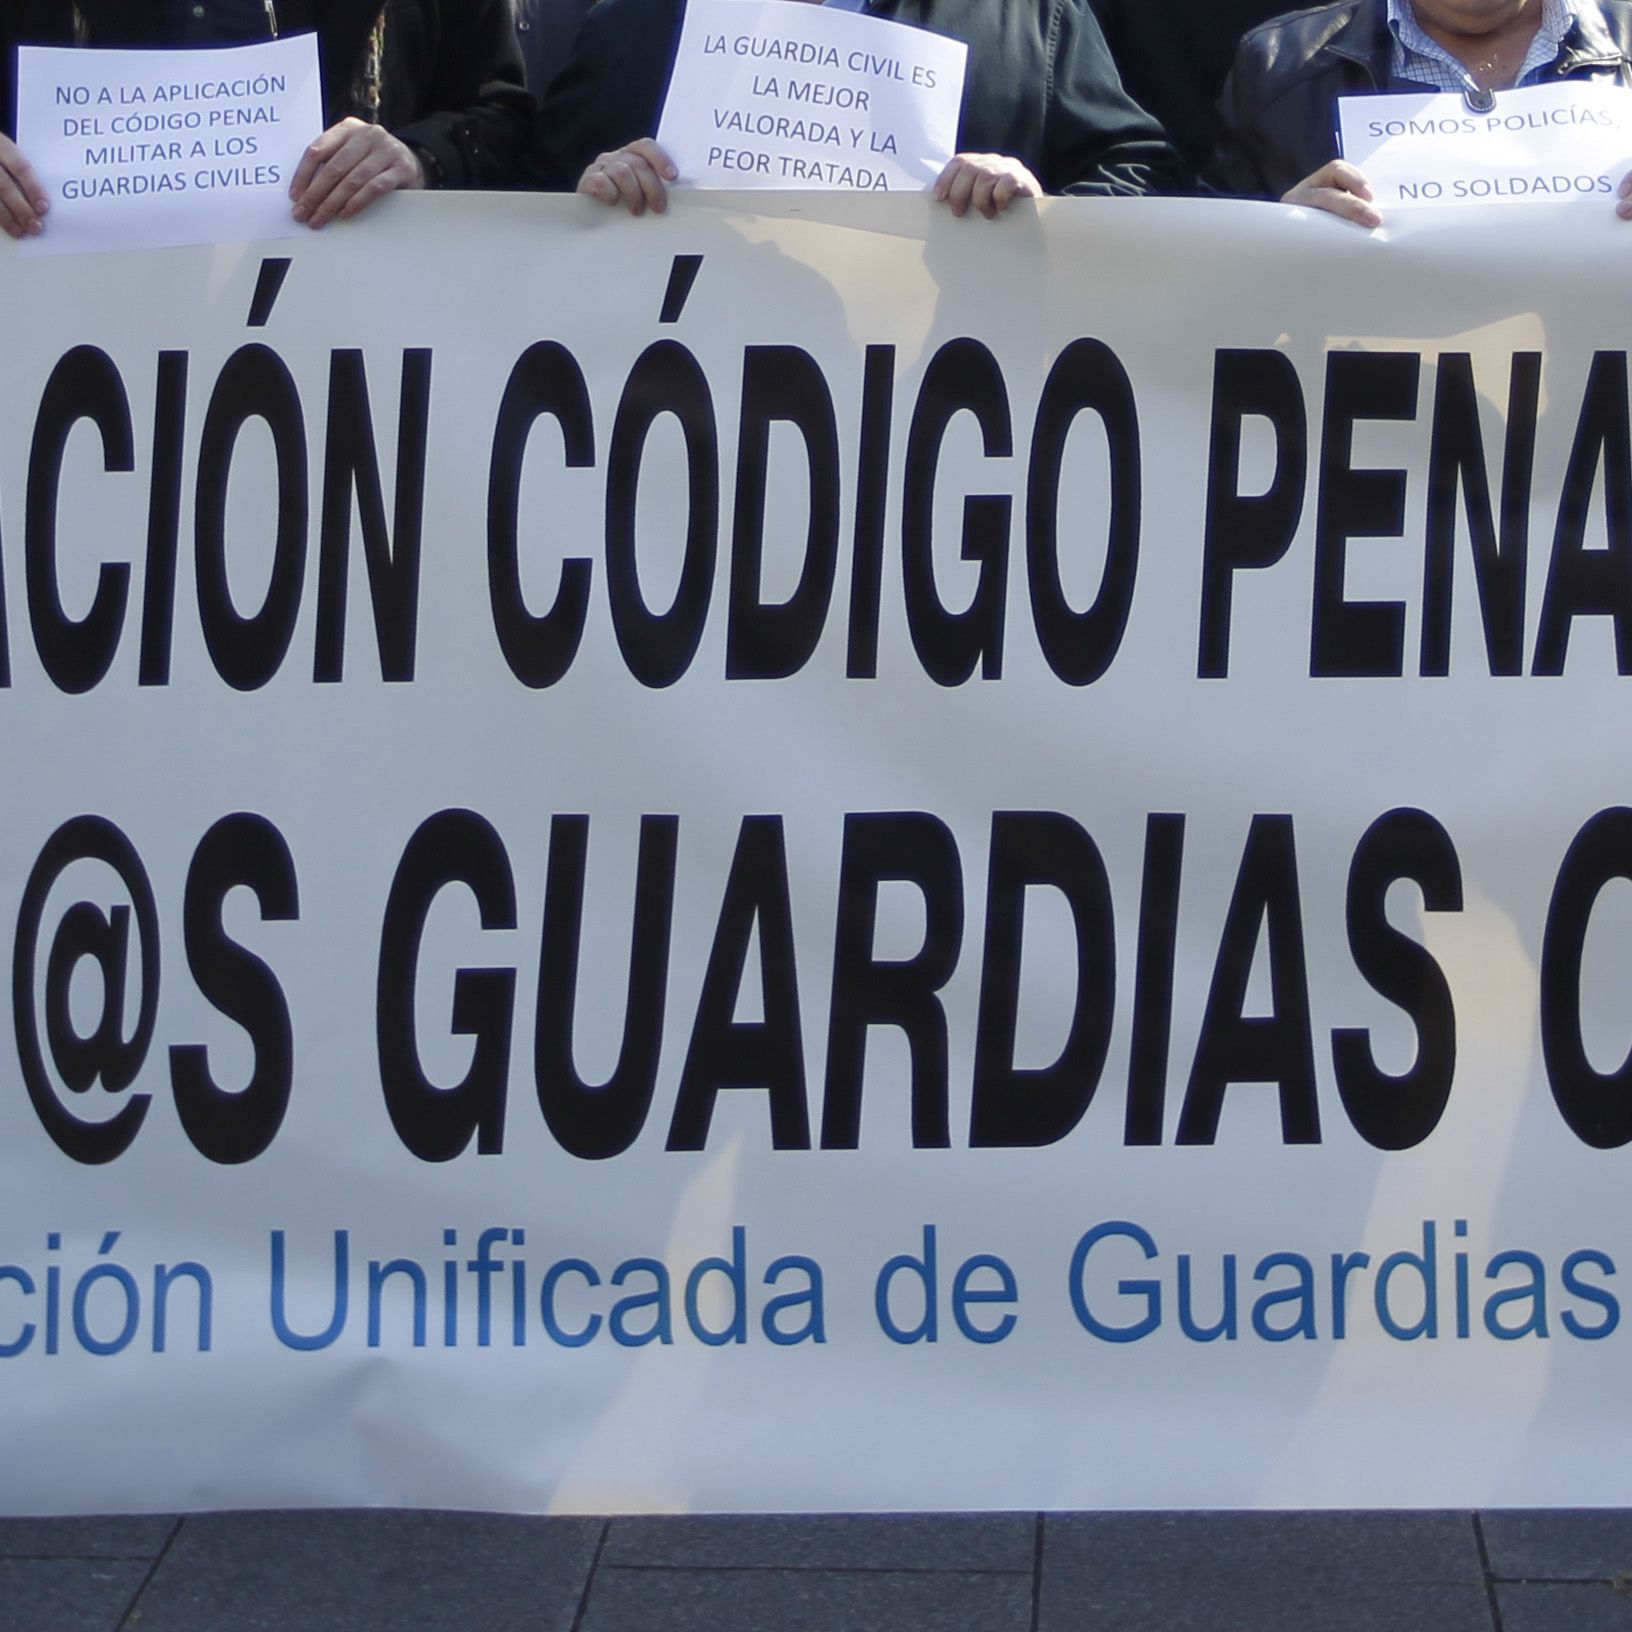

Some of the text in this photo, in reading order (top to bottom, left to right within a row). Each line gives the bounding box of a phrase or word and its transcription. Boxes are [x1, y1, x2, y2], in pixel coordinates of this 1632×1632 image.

[704, 35, 936, 88] LA GUARDIA CIVIL ES
[56, 73, 286, 105] NO A LA APLICACIÓN
[752, 75, 869, 111] LA MEJOR
[63, 106, 280, 137] DEL CÓDIGO PENAL
[714, 109, 897, 155] VALORADA Y LA
[1368, 119, 1476, 138] SOMOS
[85, 136, 258, 166] MILITAR A LOS
[708, 146, 888, 191] PEOR TRATADA
[61, 165, 281, 200] GUARDIAS CIVILES
[1399, 175, 1613, 200] NO SOLDADOS
[488, 255, 1141, 689] CÓDIGO
[377, 808, 1463, 1162] GUARDIAS
[272, 1227, 825, 1350] Unificada
[876, 1225, 1017, 1344] de
[1070, 1222, 1619, 1344] Guardias
